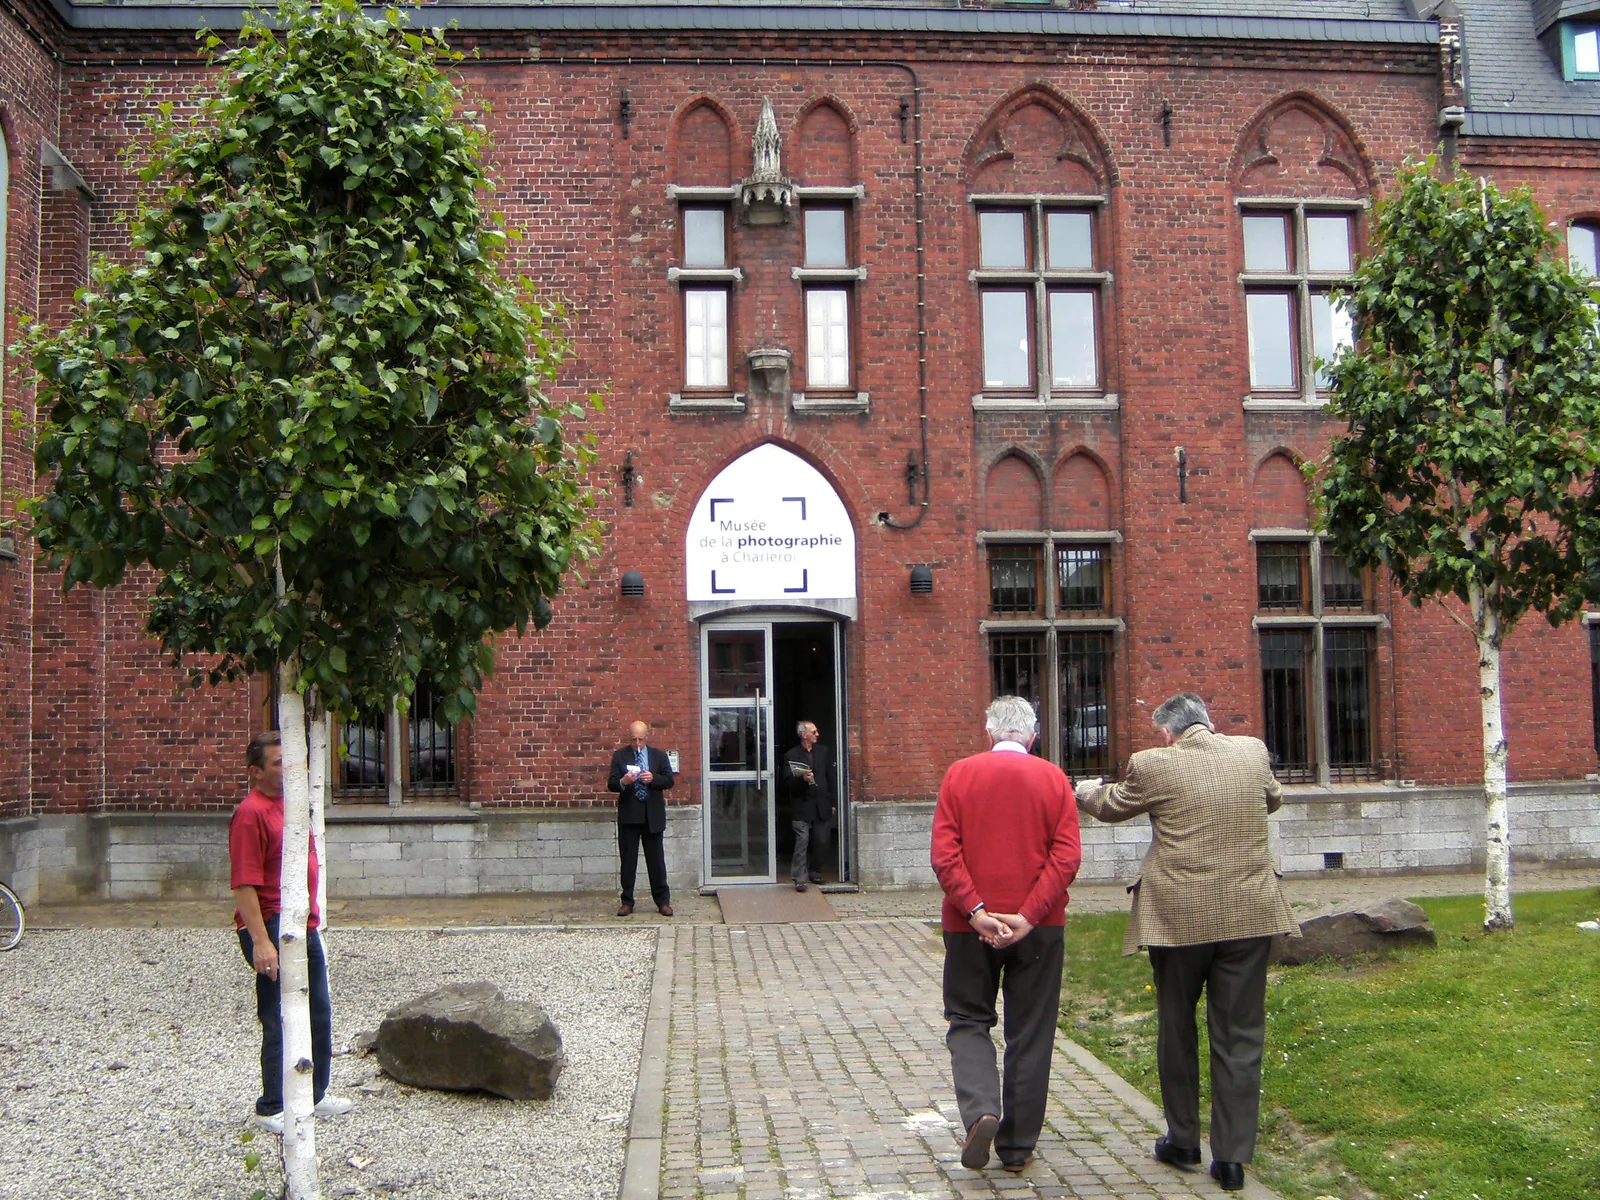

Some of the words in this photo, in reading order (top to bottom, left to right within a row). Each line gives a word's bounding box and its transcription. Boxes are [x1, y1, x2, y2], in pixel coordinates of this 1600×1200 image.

[720, 519, 767, 531] Musée
[699, 536, 717, 547] de
[721, 536, 733, 547] la
[738, 533, 843, 549] photographie
[721, 551, 729, 563] à
